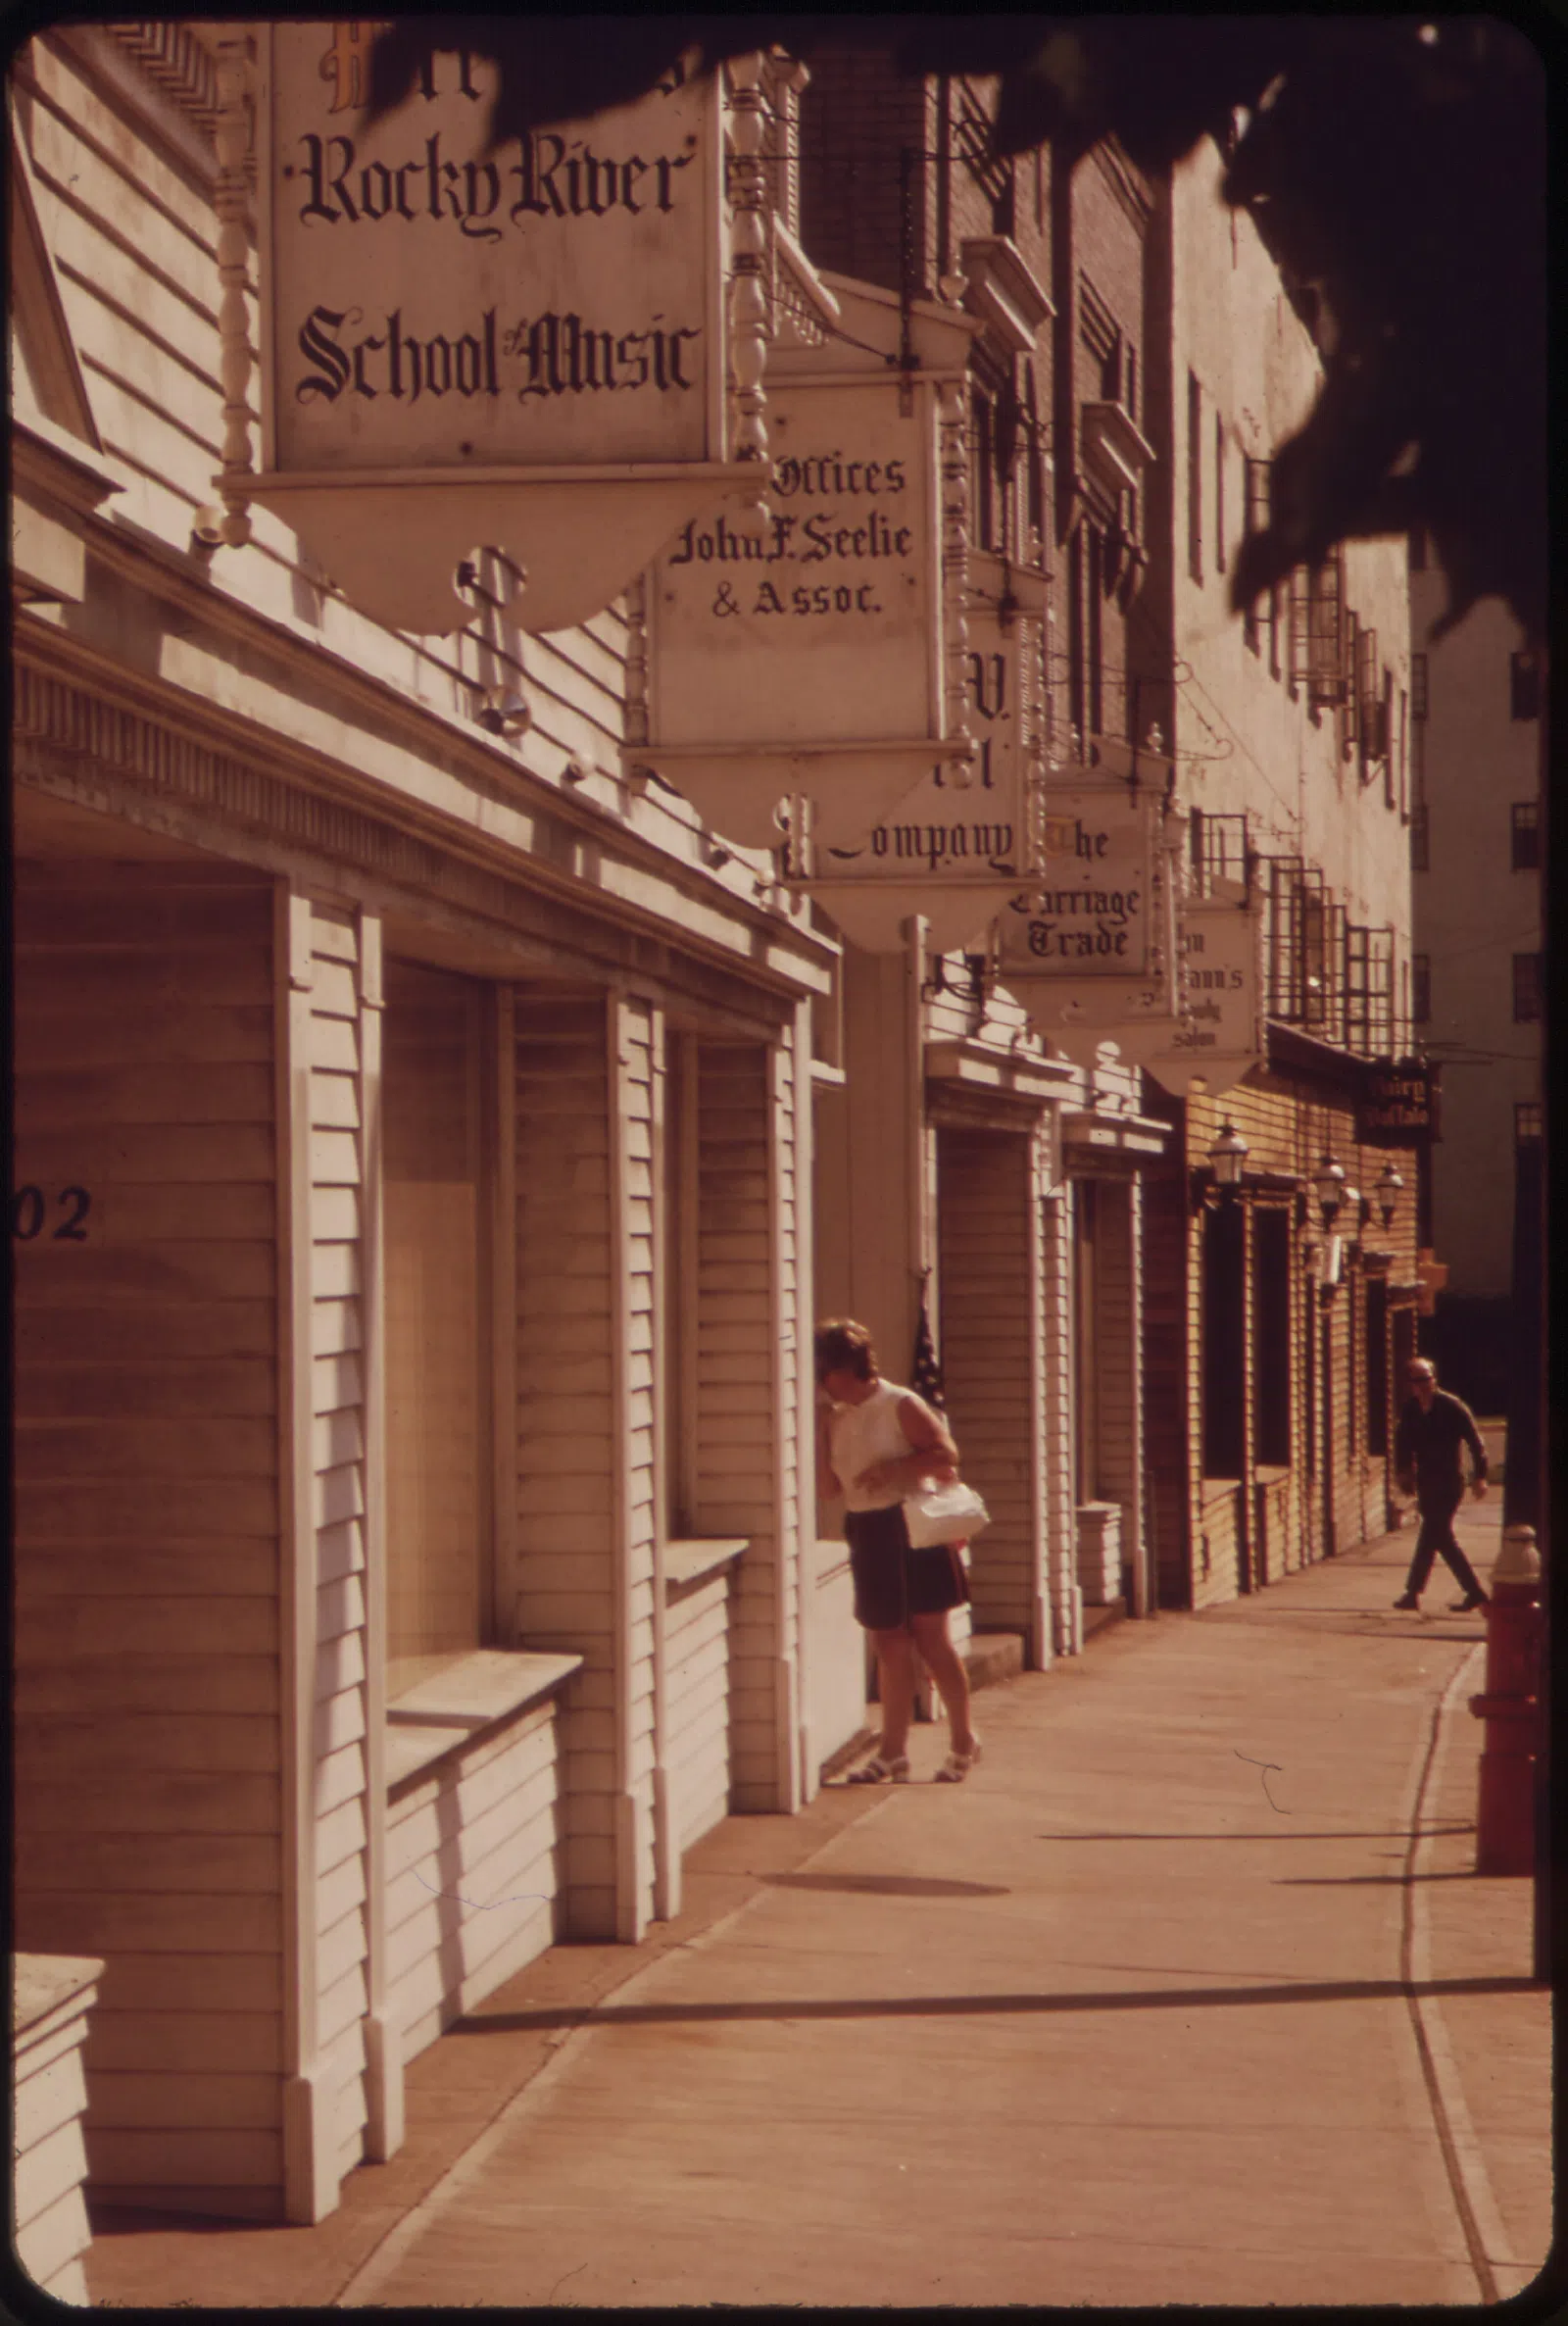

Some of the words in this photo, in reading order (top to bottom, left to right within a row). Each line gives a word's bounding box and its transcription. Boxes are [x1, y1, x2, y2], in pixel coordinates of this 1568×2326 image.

[298, 132, 502, 243] Rocky
[510, 133, 697, 227] River
[296, 305, 501, 406] School
[516, 313, 703, 406] Music
[770, 450, 906, 498] Offices
[669, 515, 764, 566] John
[800, 510, 912, 564] Seelie
[712, 580, 742, 618] &
[753, 579, 883, 617] Assoc.
[828, 822, 1015, 876] ompany
[1027, 919, 1130, 958] Trade
